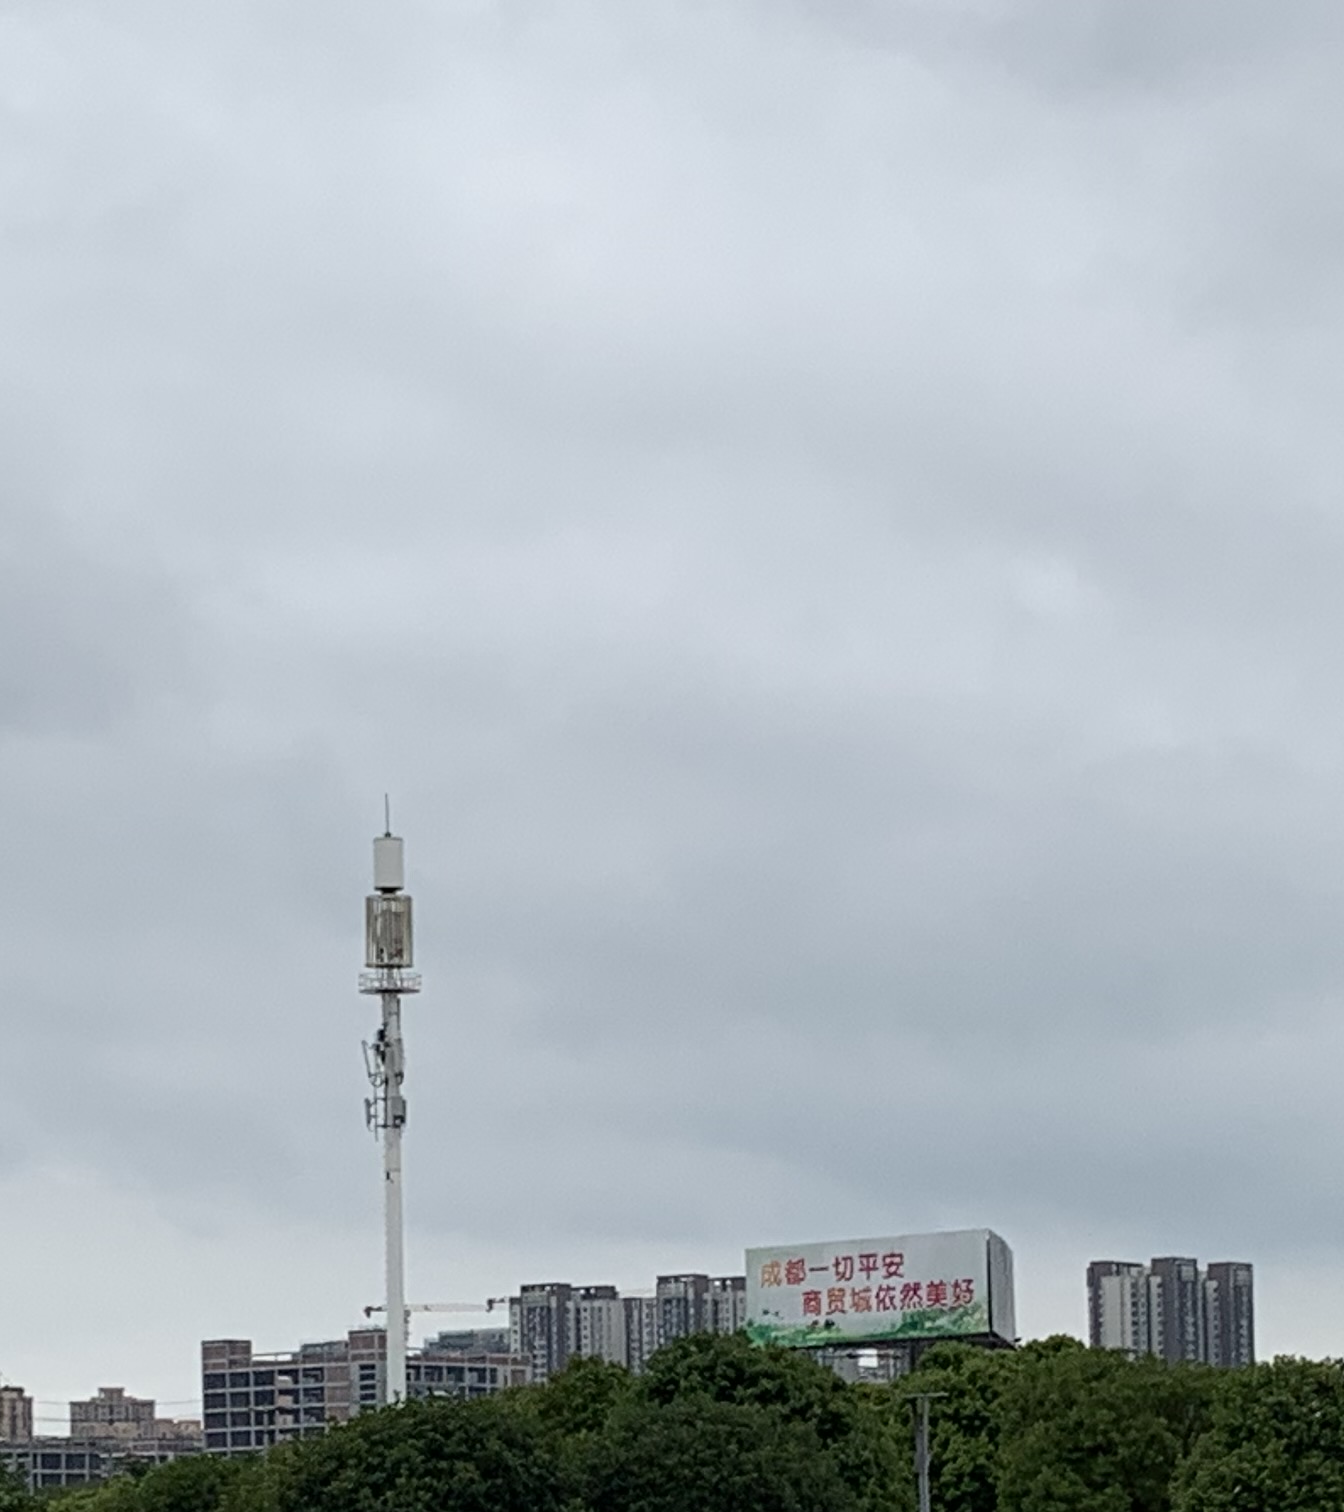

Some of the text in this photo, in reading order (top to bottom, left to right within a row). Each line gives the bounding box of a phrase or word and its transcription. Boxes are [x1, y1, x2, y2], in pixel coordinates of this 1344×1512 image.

[760, 1252, 904, 1288] 成都一切平安
[802, 1279, 974, 1316] 商贸城依然美好
